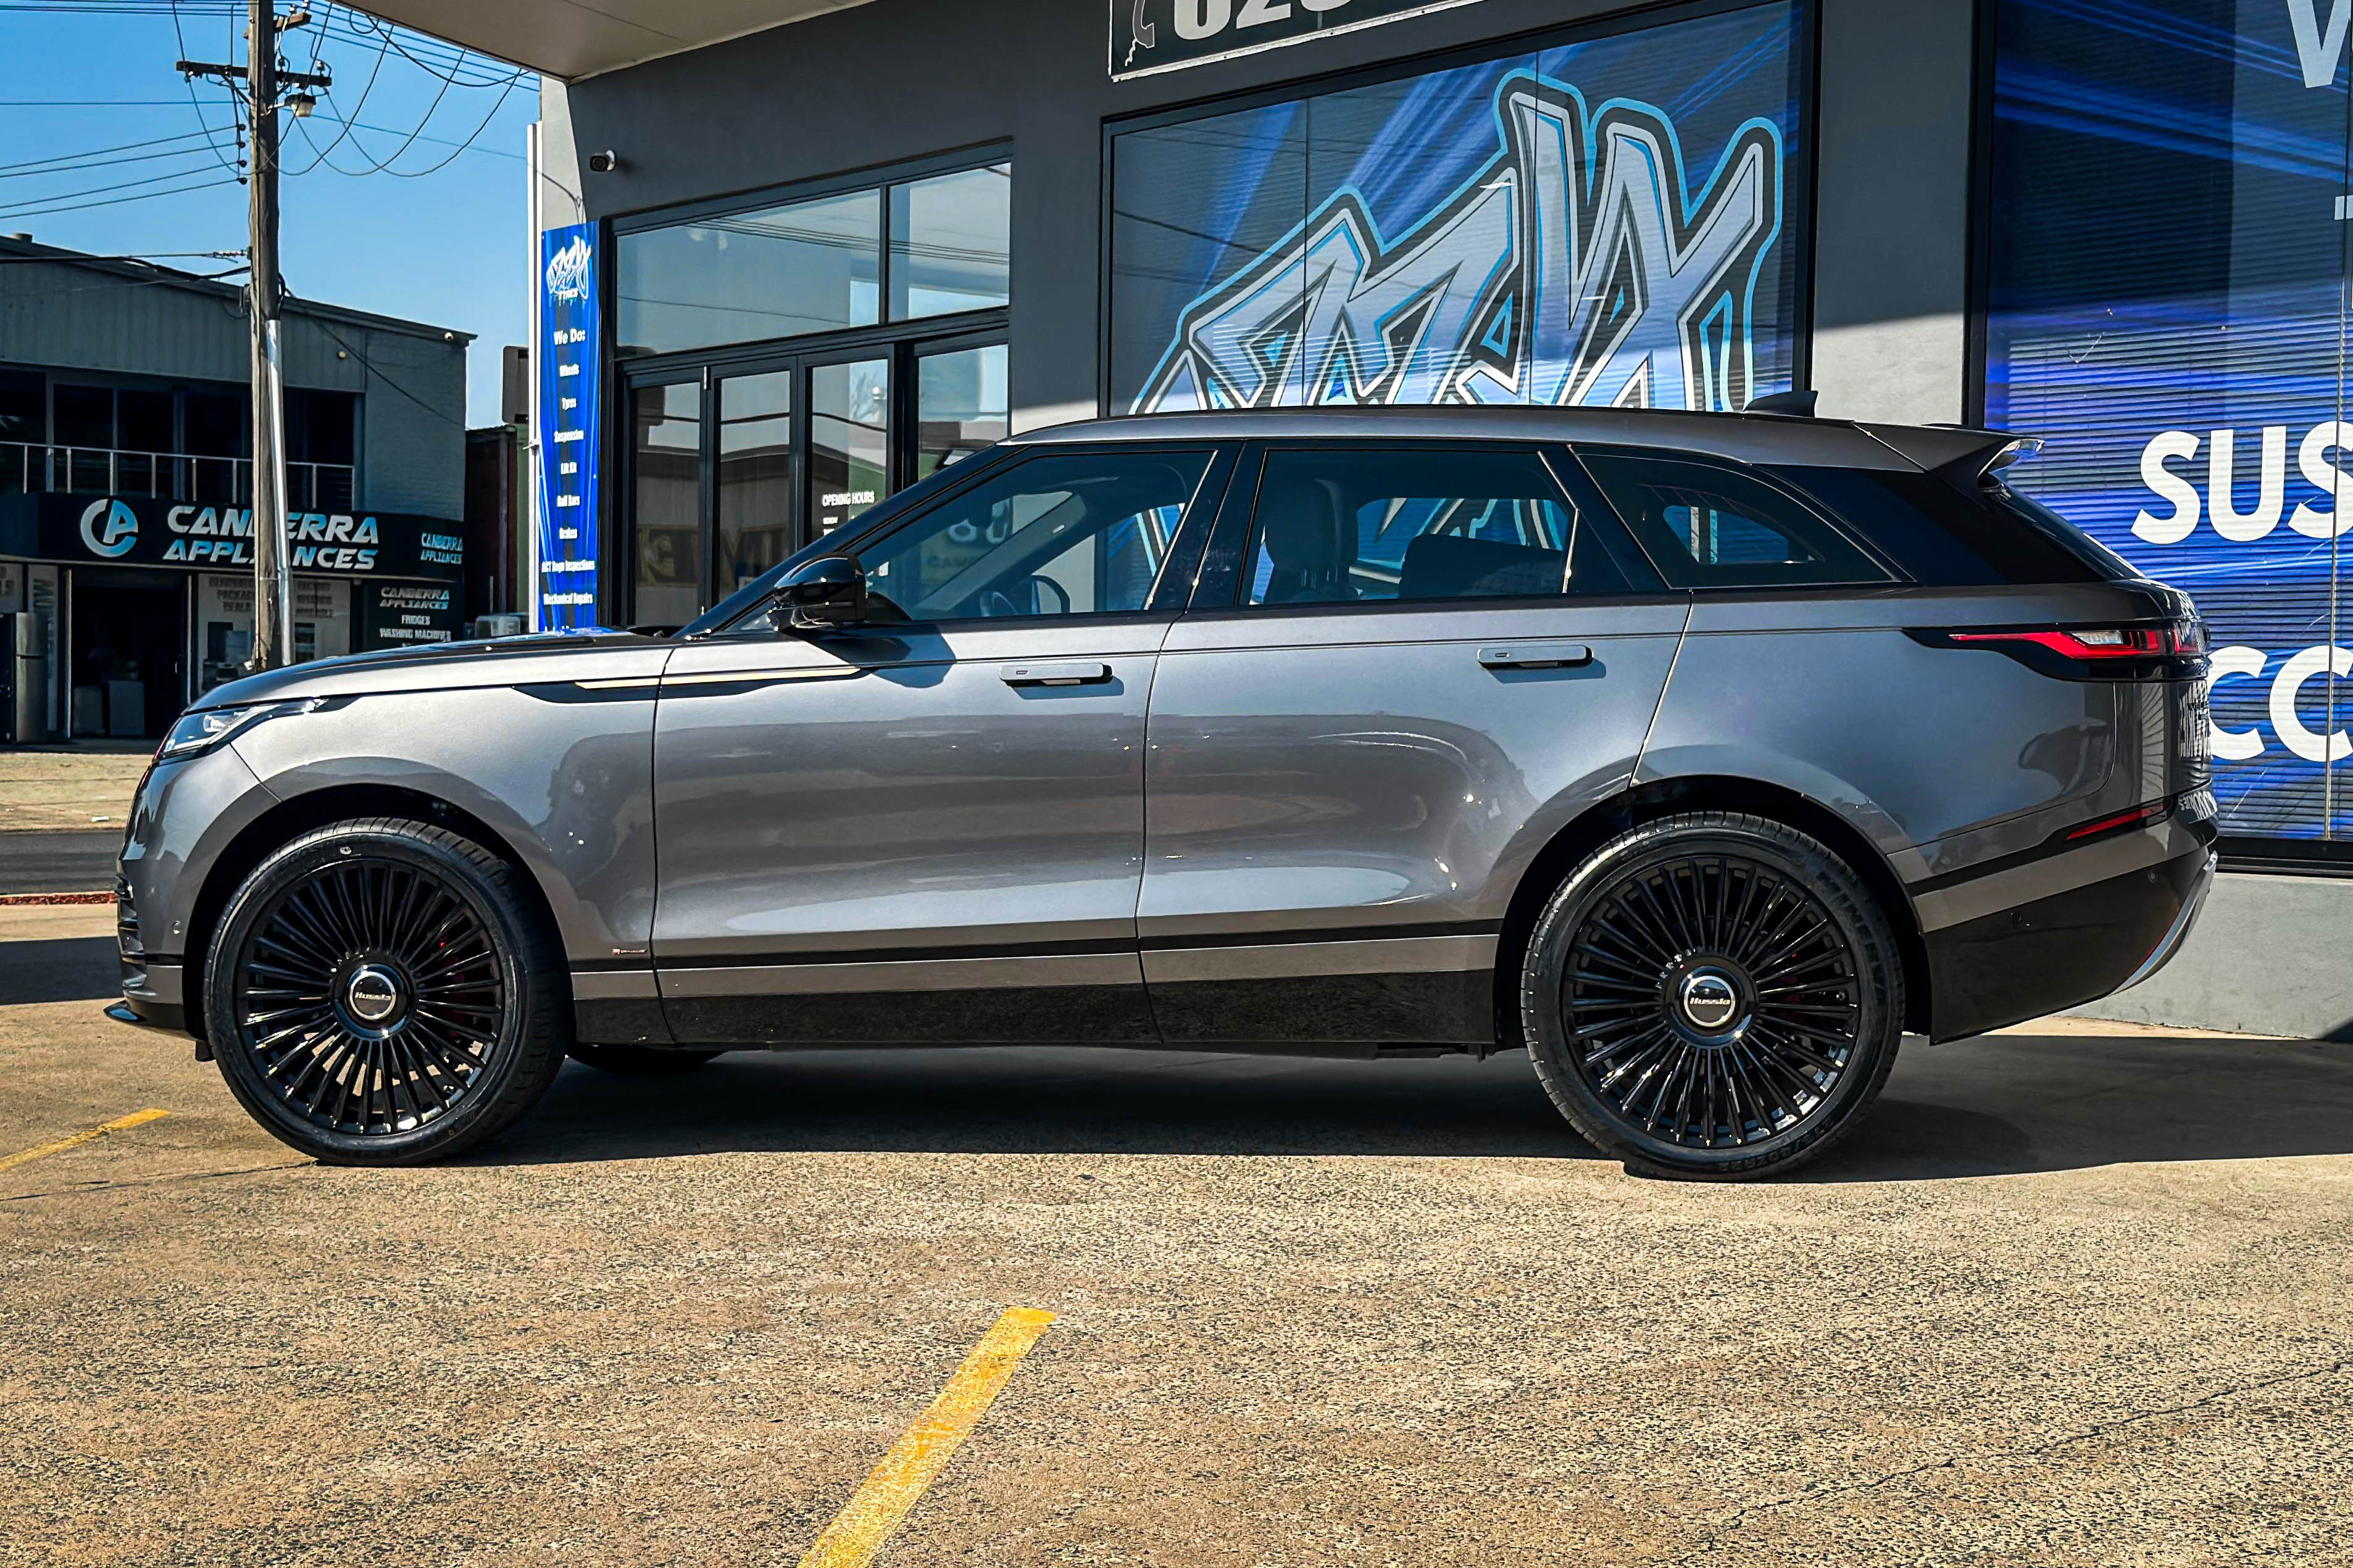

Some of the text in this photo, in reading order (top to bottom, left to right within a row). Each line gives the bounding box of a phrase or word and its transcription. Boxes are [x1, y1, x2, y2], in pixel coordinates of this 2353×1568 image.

[554, 328, 586, 346] We Do:
[822, 491, 875, 507] OPENING HOURS
[167, 505, 379, 544] CANERRA
[421, 533, 463, 552] CANBERRA
[162, 539, 379, 570] APPLNCES
[420, 549, 462, 565] APPLIANCES
[381, 587, 450, 600] CANBERRA
[379, 599, 449, 610] APPLIANCES
[401, 615, 431, 626] FRIDGES
